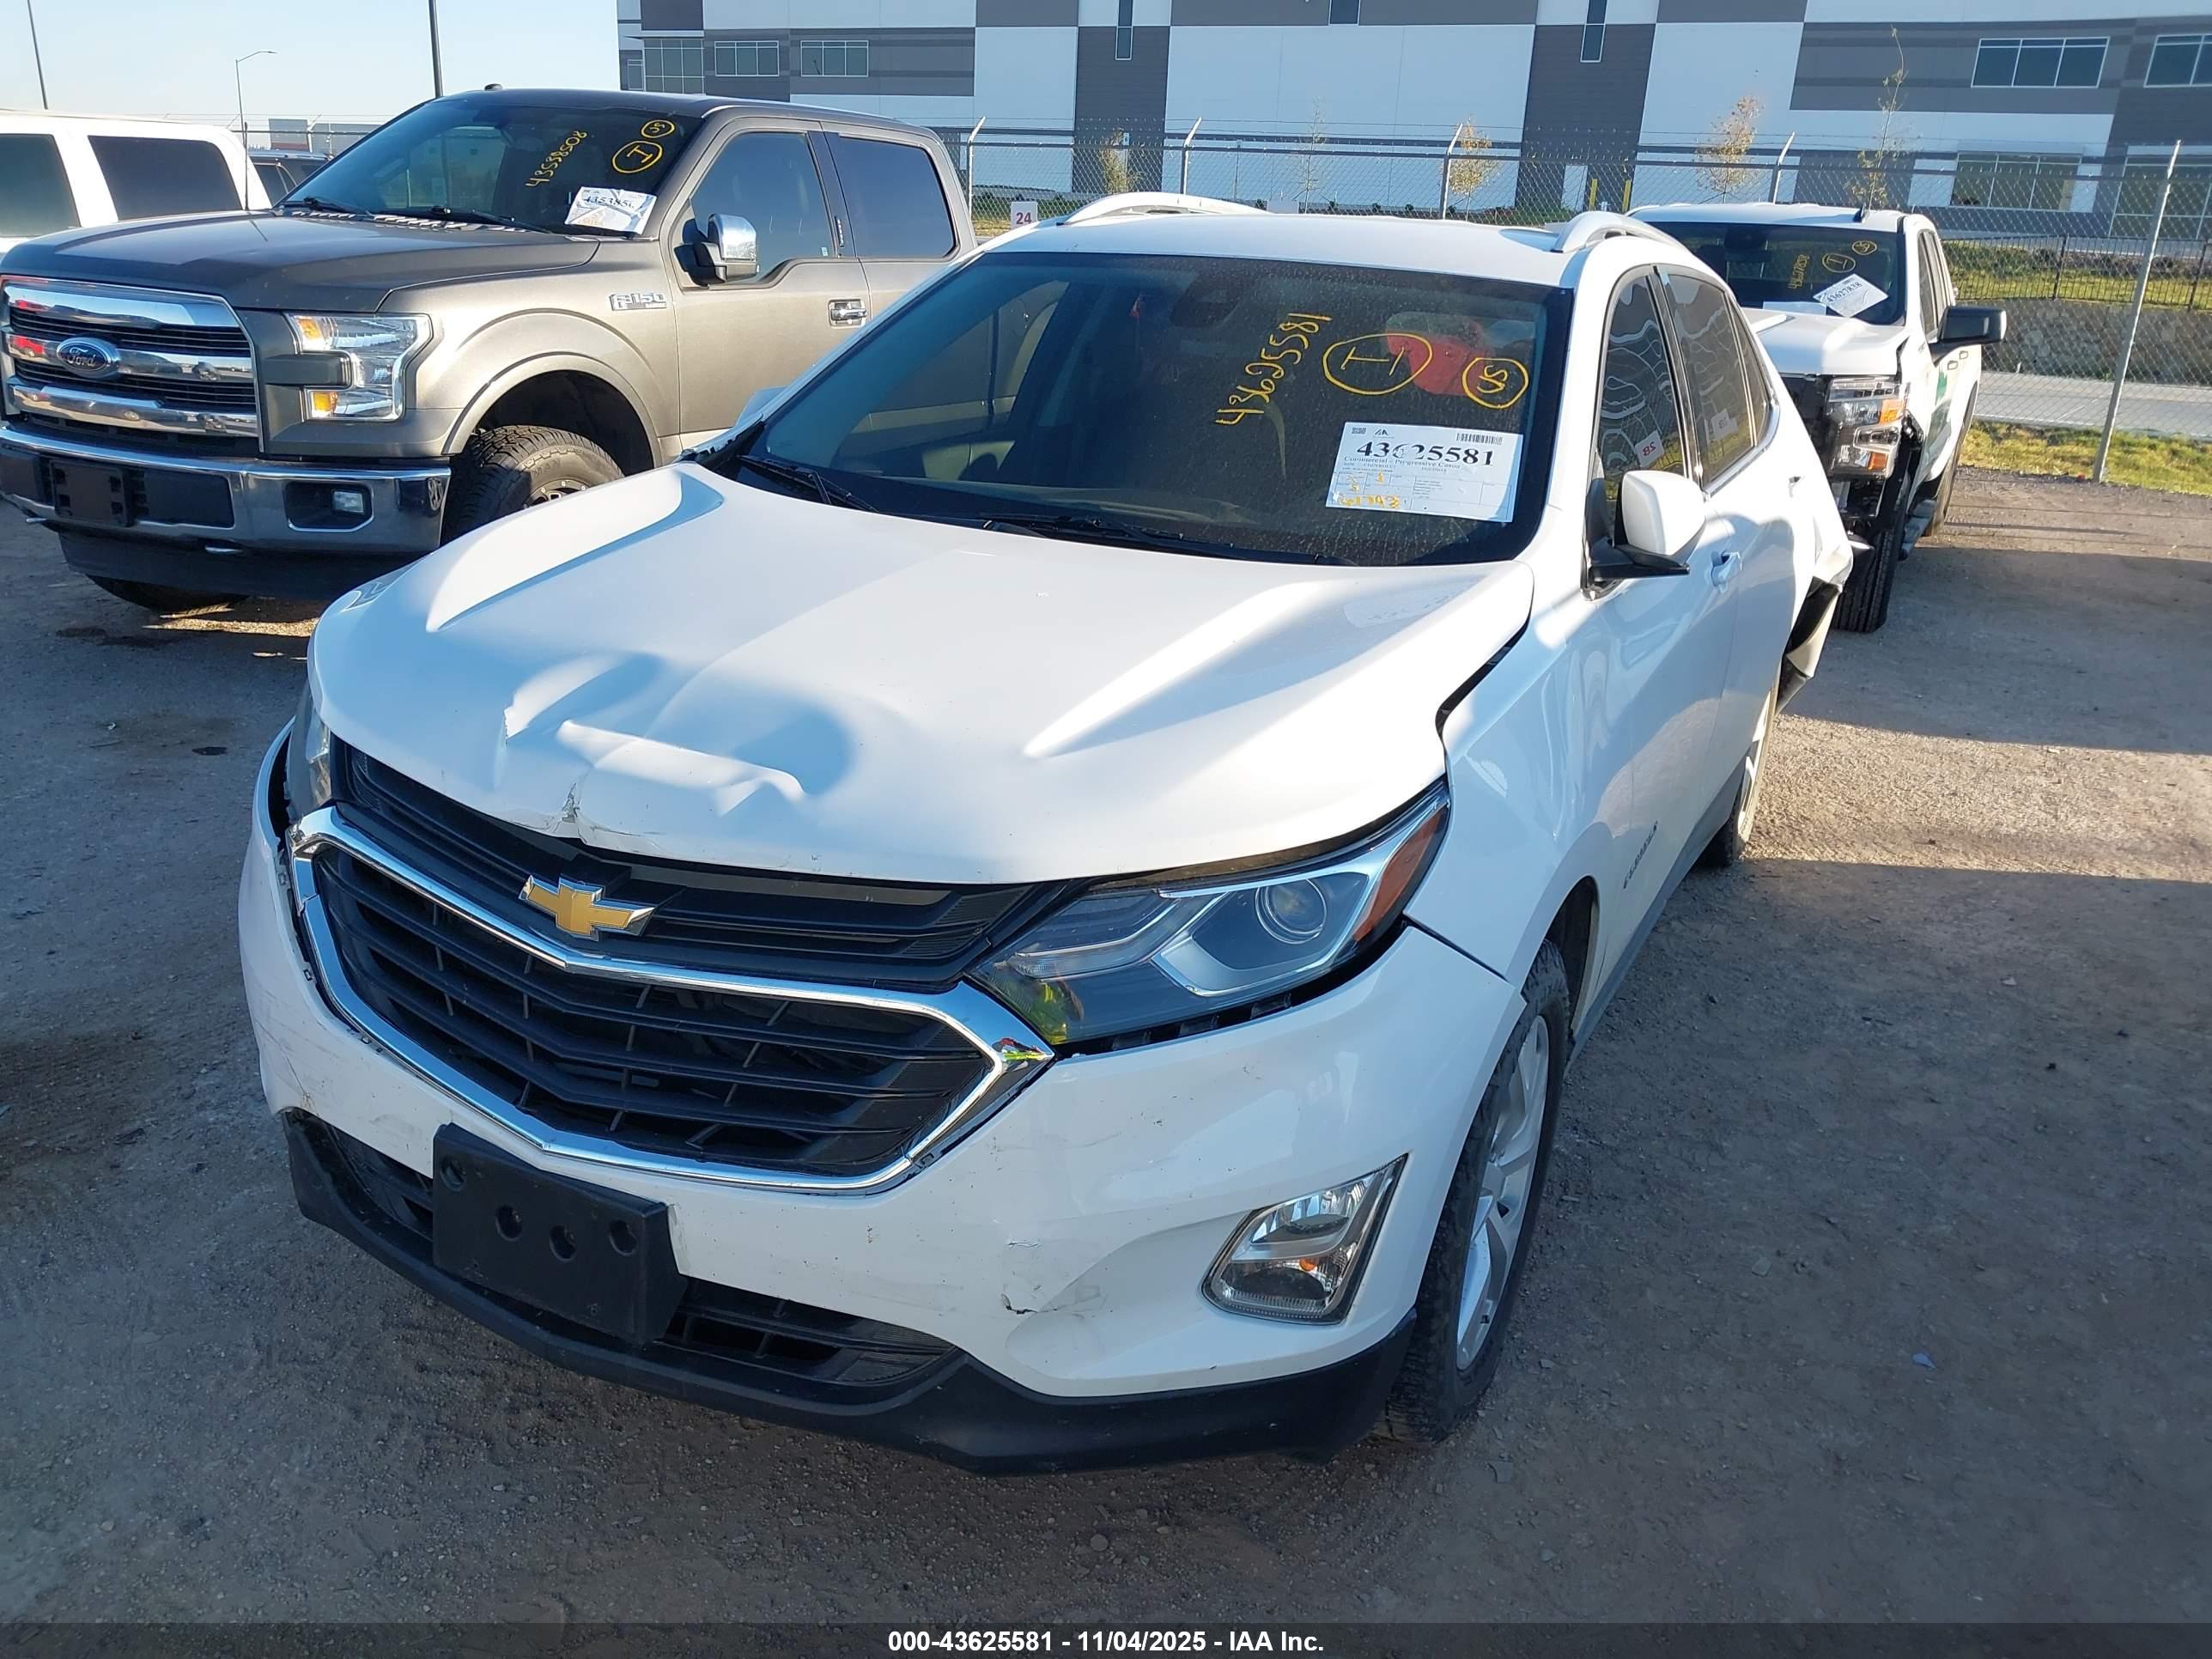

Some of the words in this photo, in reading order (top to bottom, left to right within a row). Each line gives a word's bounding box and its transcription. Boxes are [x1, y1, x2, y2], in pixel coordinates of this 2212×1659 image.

[525, 131, 587, 186] 43538508
[1016, 212, 1031, 224] 24
[67, 346, 96, 367] Ford
[1215, 313, 1332, 425] 43625581
[1357, 441, 1493, 466] 43625581
